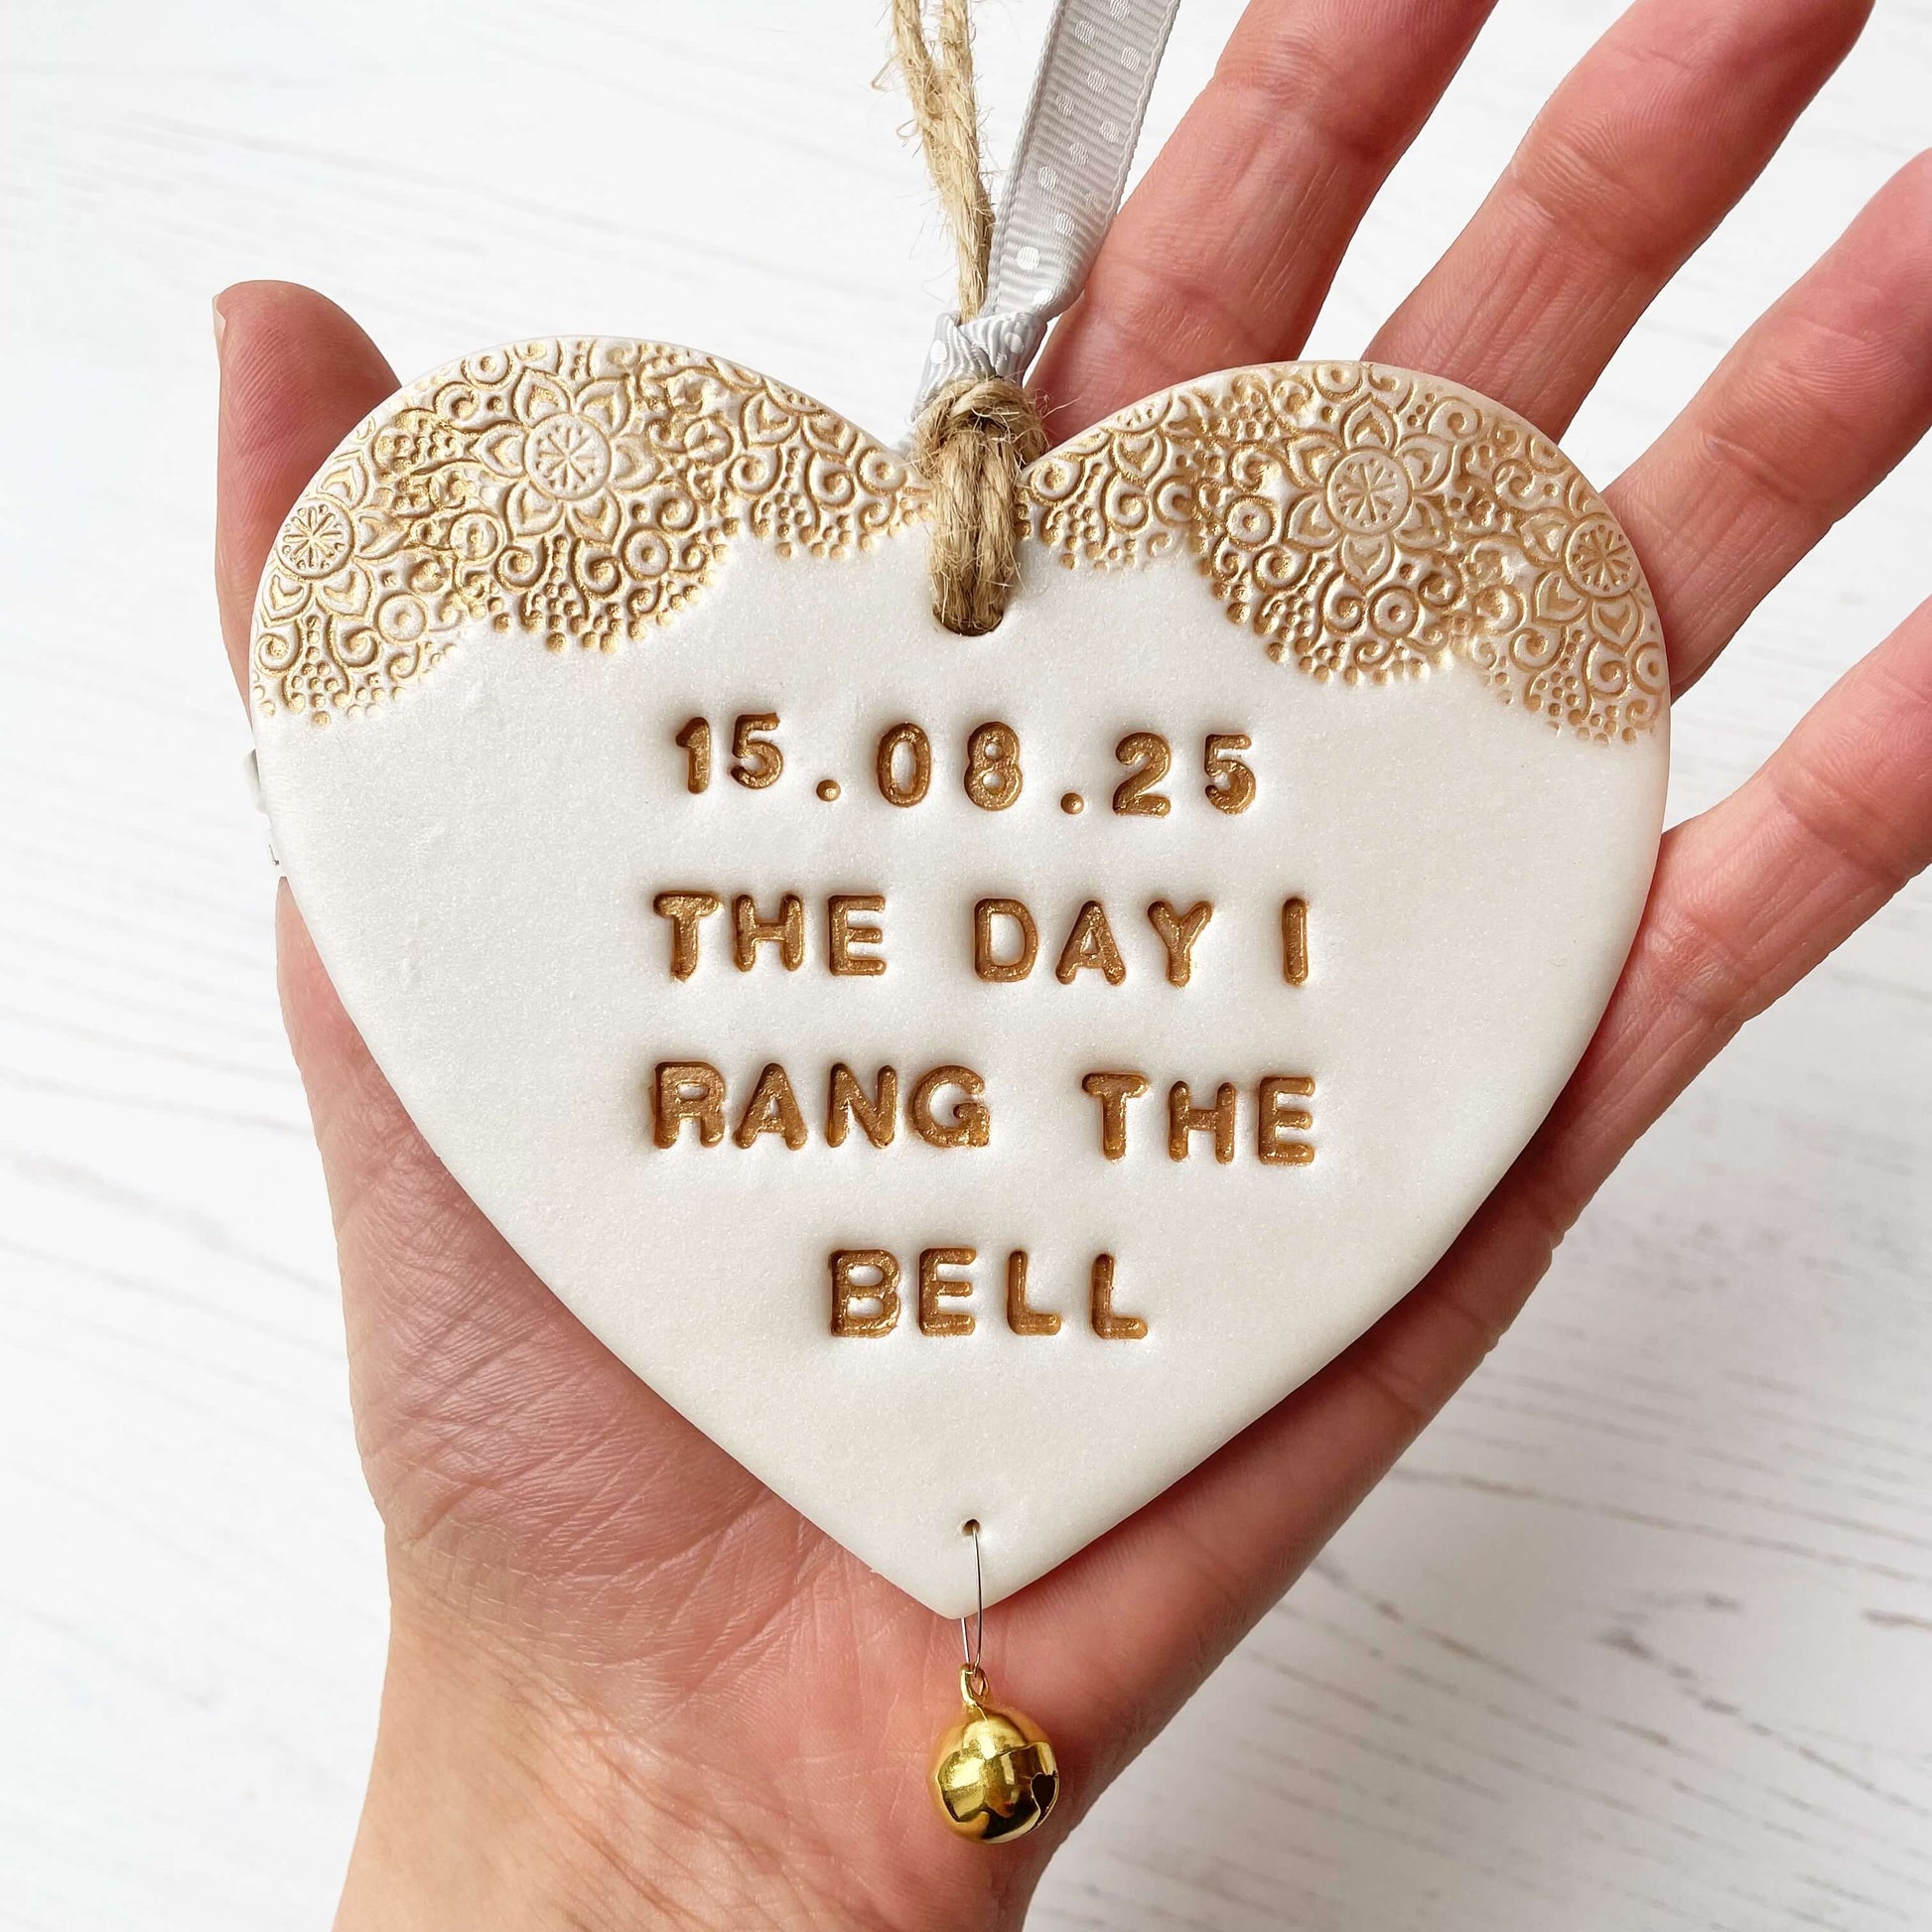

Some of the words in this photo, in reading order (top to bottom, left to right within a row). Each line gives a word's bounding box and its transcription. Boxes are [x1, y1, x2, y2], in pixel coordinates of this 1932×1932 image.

[675, 713, 1256, 816] 15.08.25
[653, 893, 886, 981] THE
[972, 897, 1213, 987] DAY
[1282, 896, 1309, 987] I
[651, 1060, 990, 1150] RANG
[1082, 1071, 1314, 1166] THE
[829, 1247, 1148, 1339] BELL
